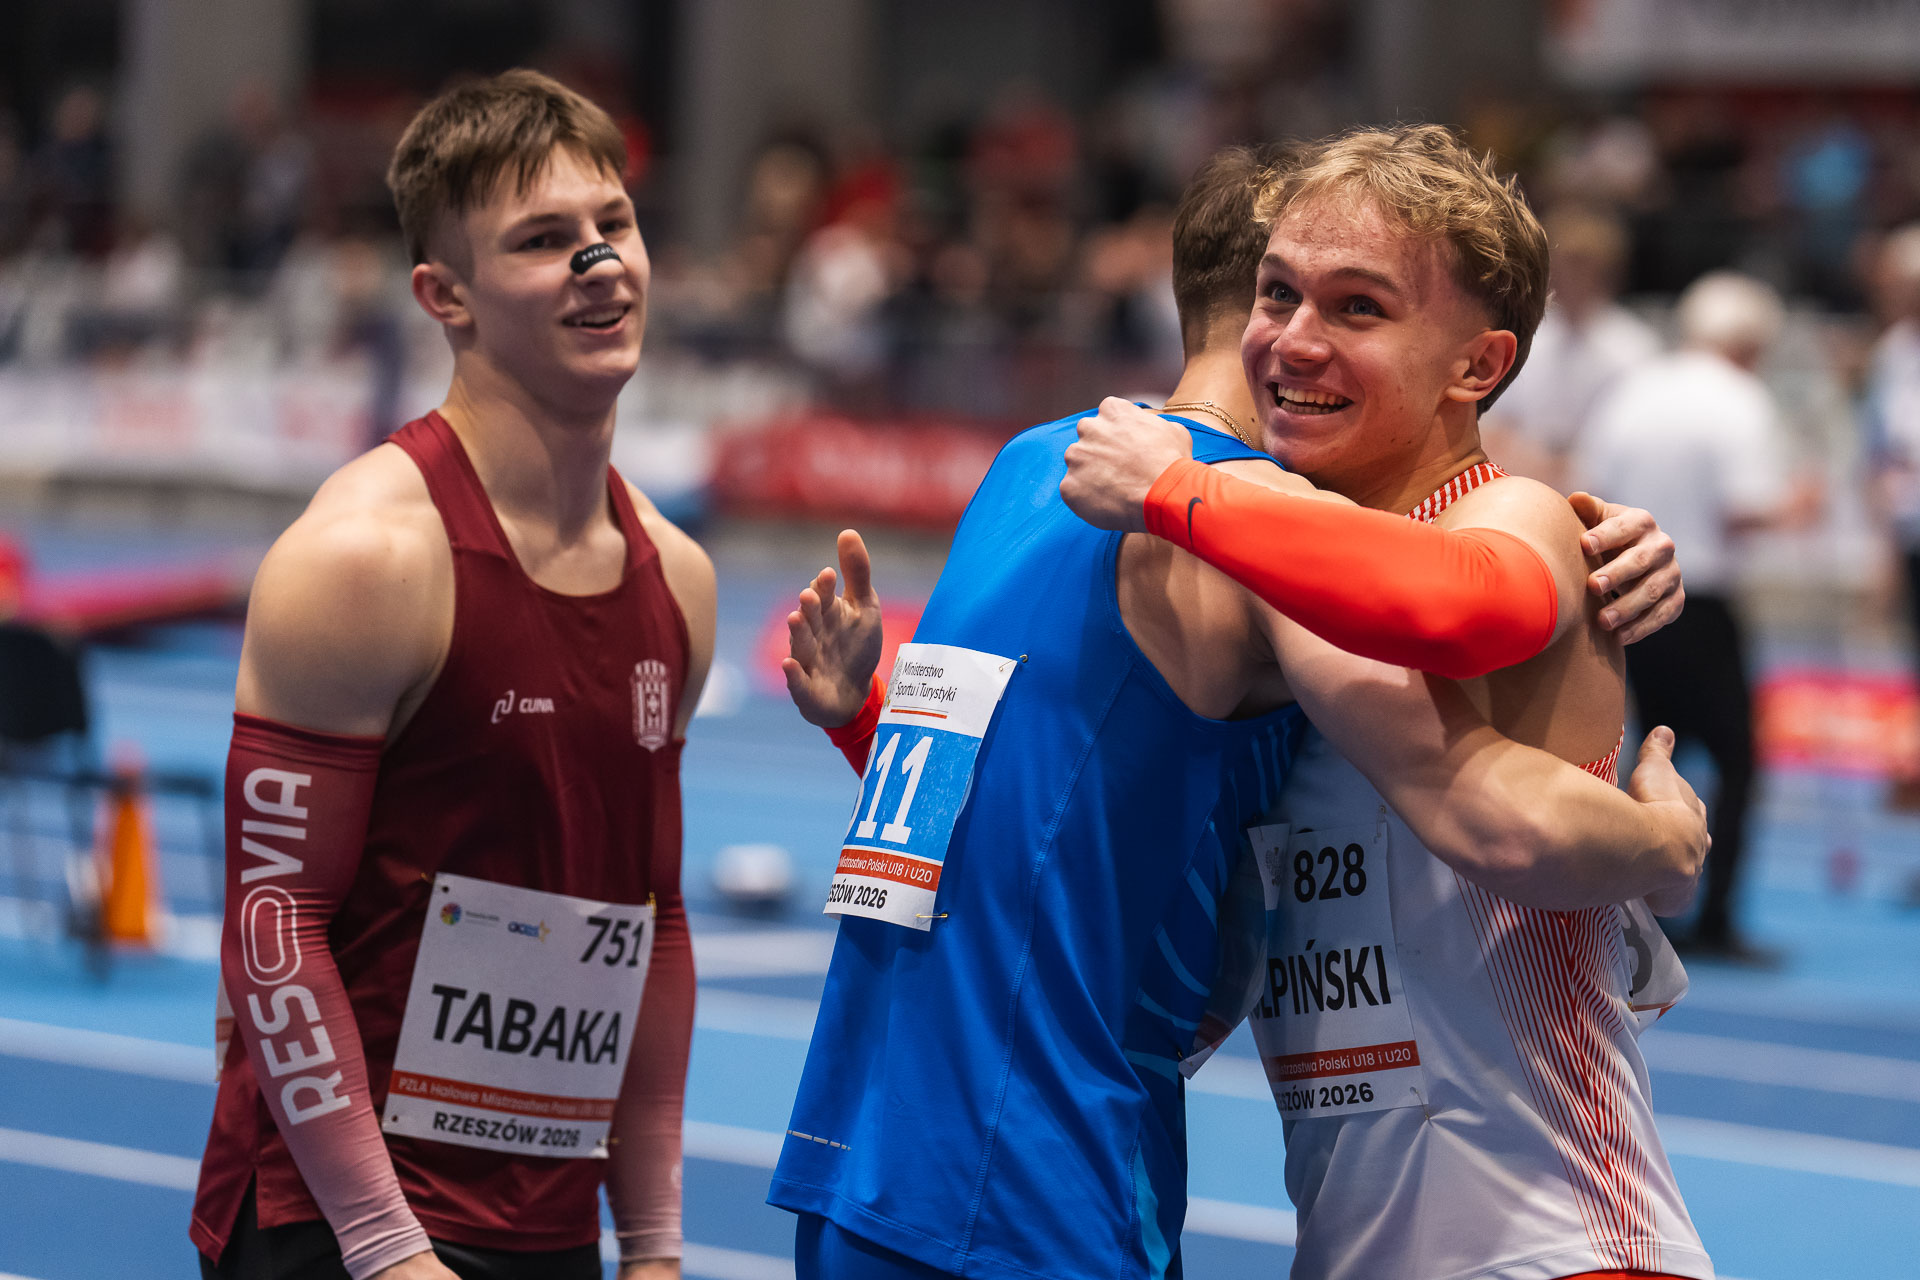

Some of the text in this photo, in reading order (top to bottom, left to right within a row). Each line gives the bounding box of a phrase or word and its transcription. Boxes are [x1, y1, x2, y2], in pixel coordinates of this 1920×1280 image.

[902, 661, 944, 678] Ministerstwo
[895, 681, 917, 698] Sportu
[919, 683, 957, 702] Turystyki
[519, 698, 555, 713] CUNA
[844, 731, 934, 845] 11
[866, 858, 889, 873] Polski
[888, 862, 904, 877] U18
[910, 867, 933, 883] U20
[1293, 843, 1367, 902] 828
[854, 885, 888, 909] 2026
[241, 767, 352, 1126] RESOVIA
[580, 916, 644, 968] 751
[432, 983, 621, 1065] TABAKA
[1319, 1056, 1351, 1071] Polski
[1353, 1053, 1375, 1067] U18
[1378, 1051, 1383, 1064] i
[1385, 1048, 1411, 1063] U20
[398, 1077, 428, 1094] PZLA
[1319, 1082, 1374, 1107] 2026
[432, 1111, 581, 1148] RZESZÓW 2026
